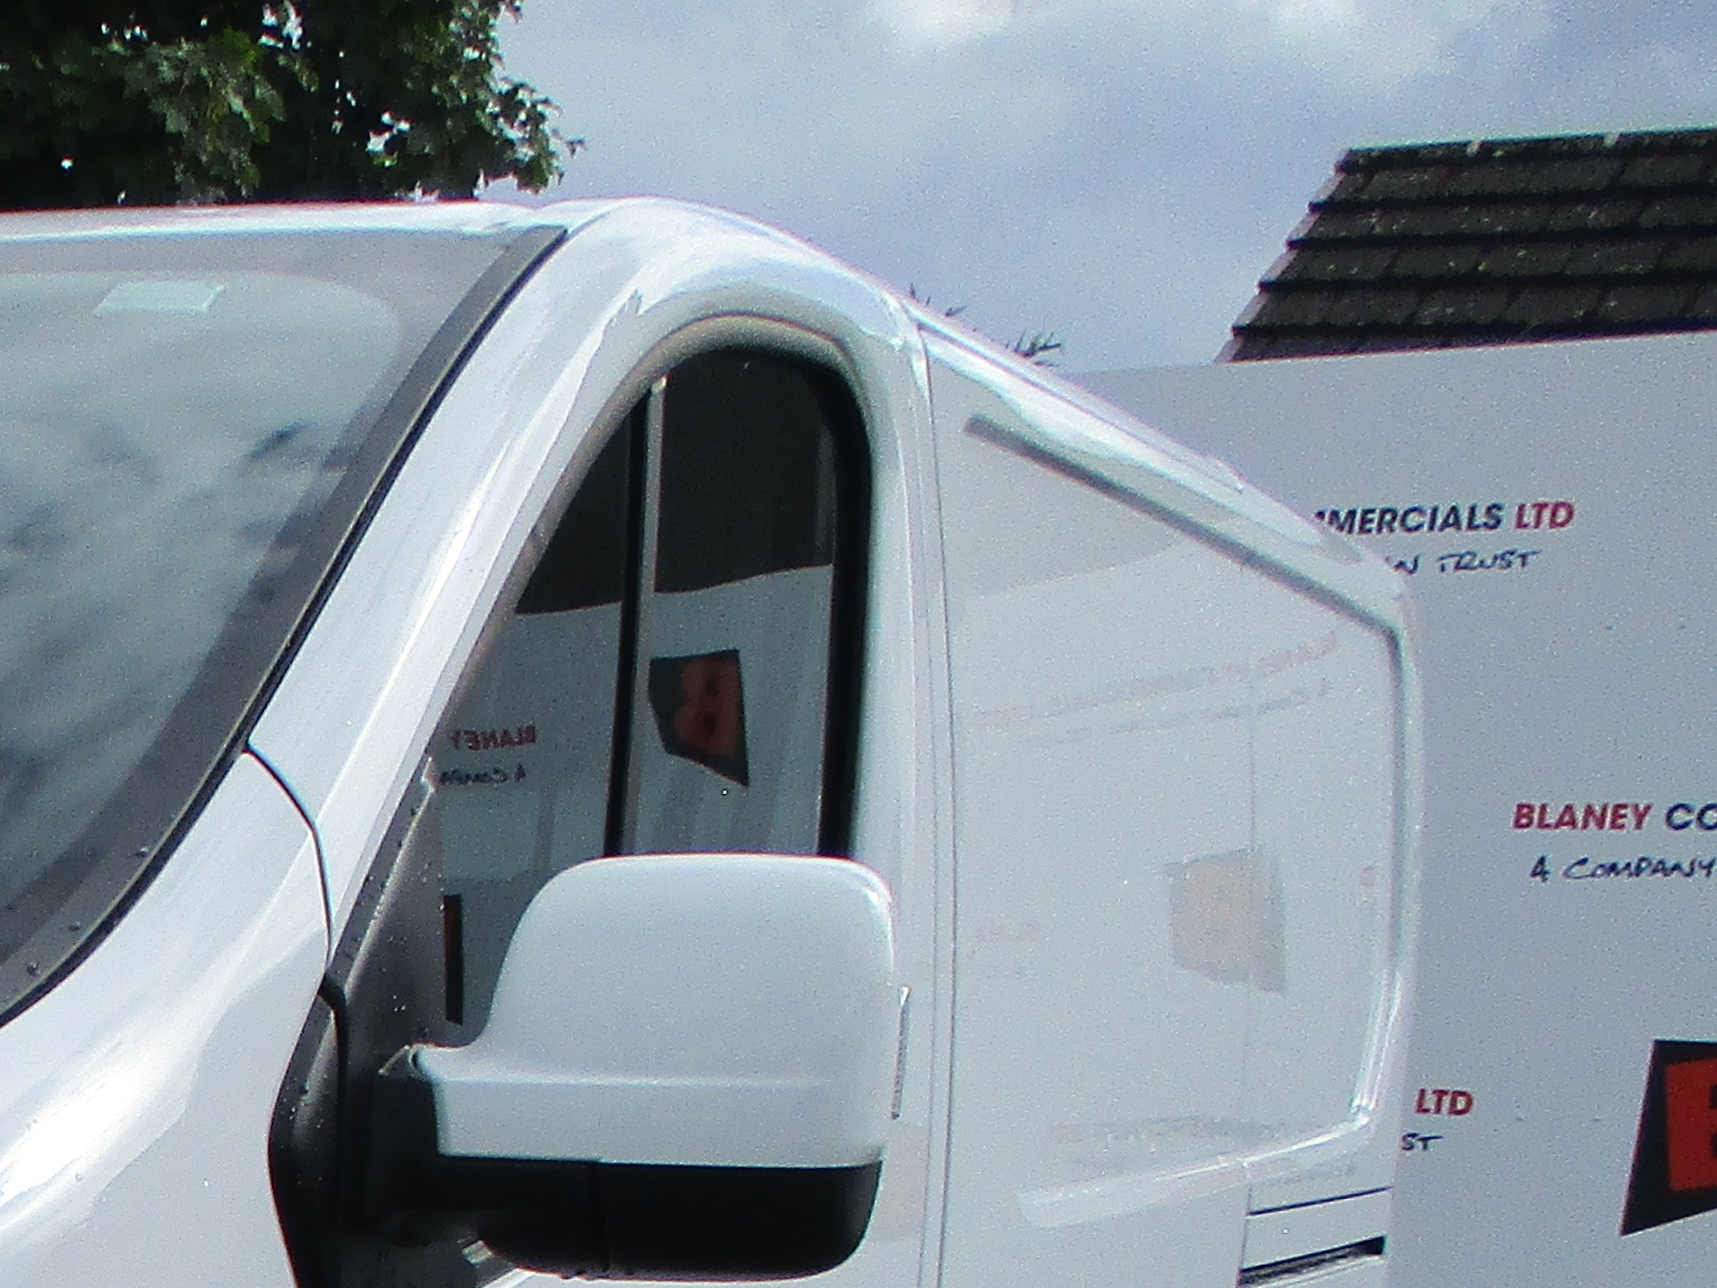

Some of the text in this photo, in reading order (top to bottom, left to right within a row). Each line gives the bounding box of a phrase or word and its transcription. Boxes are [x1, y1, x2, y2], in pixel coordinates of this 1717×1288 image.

[1315, 501, 1575, 535] MERCIALS LTD
[1437, 549, 1543, 573] TRUST
[1513, 803, 1654, 831] BLANEY
[1563, 856, 1717, 880] COMPANY
[1415, 1088, 1474, 1116] LTD
